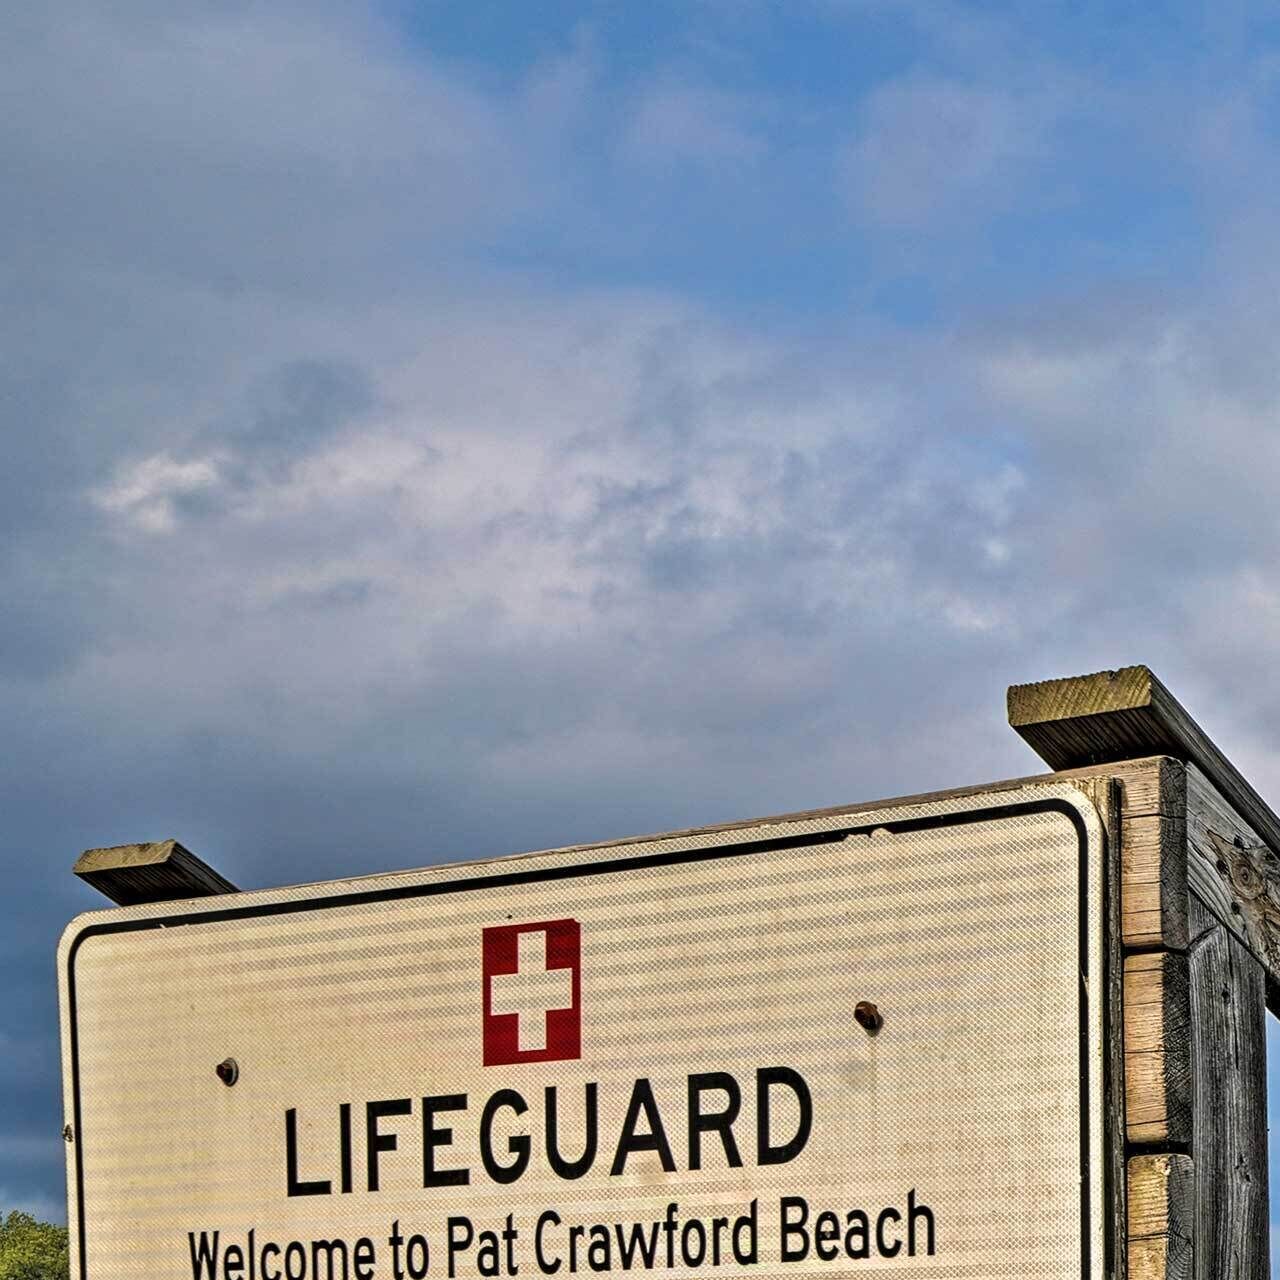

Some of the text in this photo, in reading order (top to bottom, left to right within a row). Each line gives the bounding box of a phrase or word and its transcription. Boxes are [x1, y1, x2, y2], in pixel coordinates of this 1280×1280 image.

[285, 1066, 813, 1198] LIFEGUARD
[447, 1212, 519, 1279] Pat
[534, 1198, 758, 1275] Crawford
[780, 1188, 935, 1263] Beach
